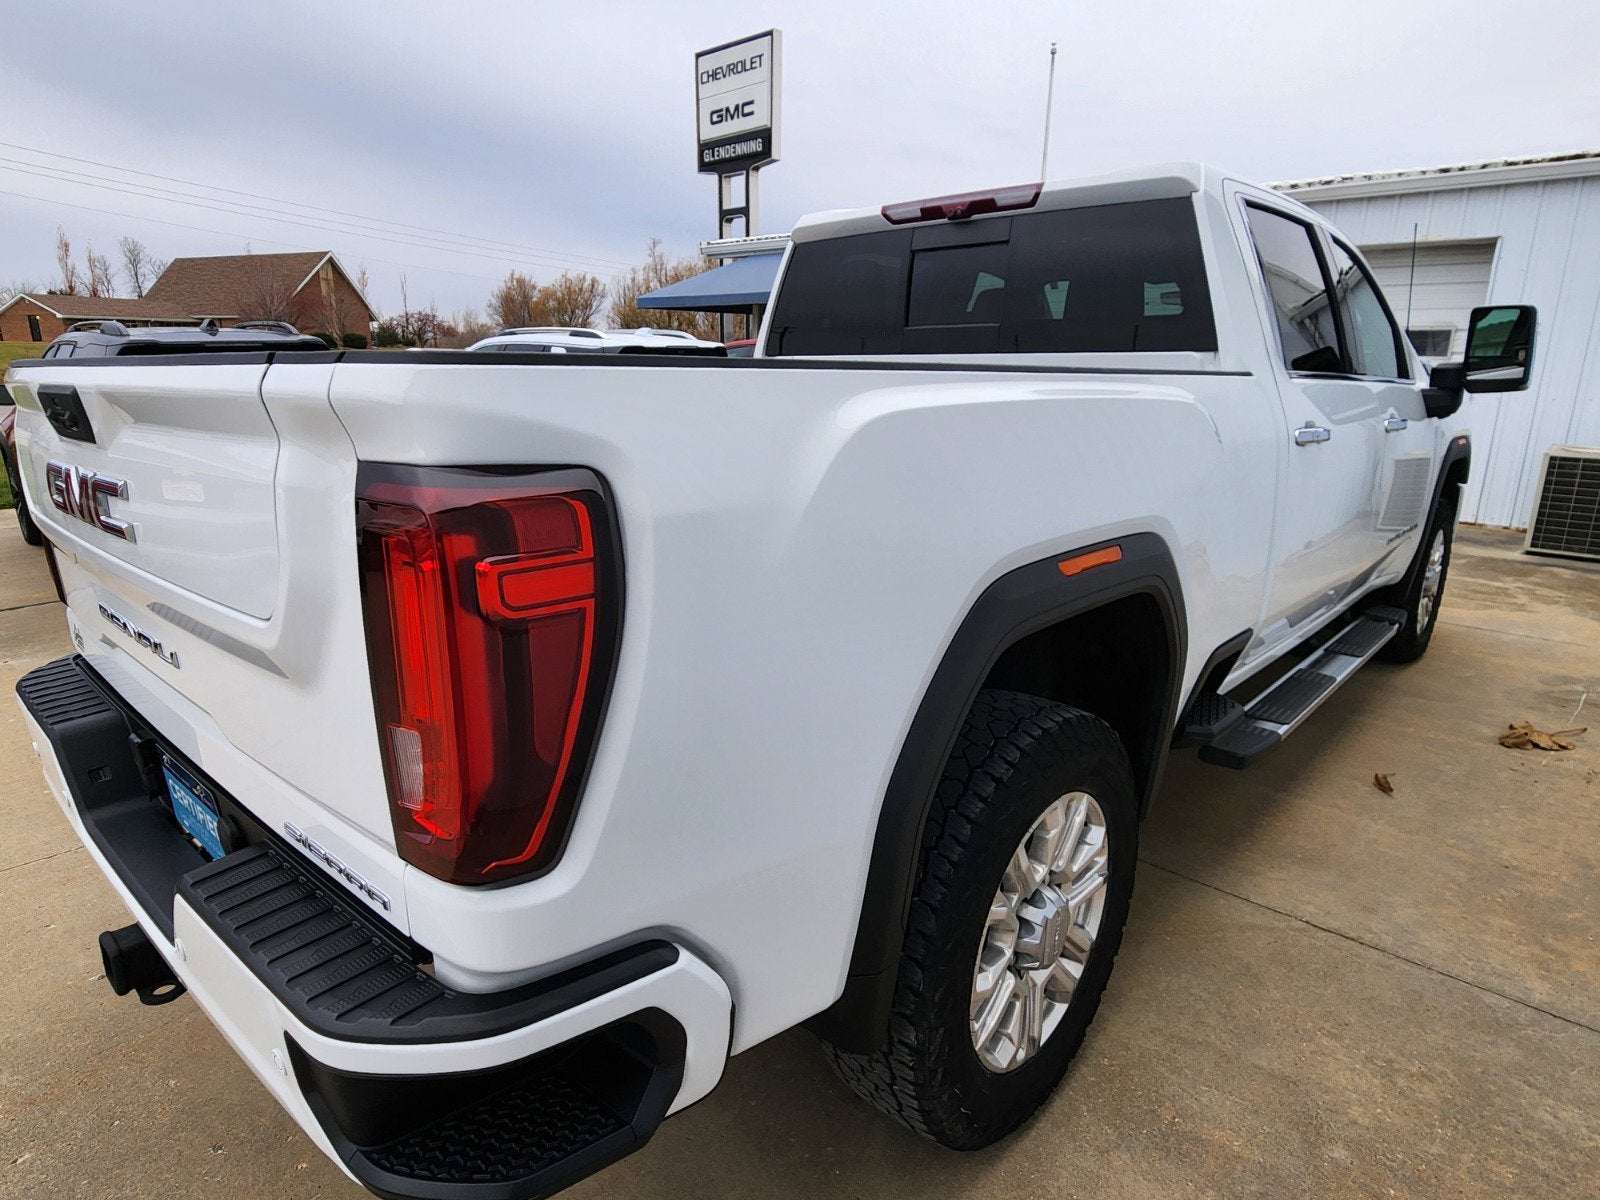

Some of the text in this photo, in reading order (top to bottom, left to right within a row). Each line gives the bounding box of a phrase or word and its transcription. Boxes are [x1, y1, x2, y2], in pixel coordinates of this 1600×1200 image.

[700, 53, 764, 85] CHEVROLET
[710, 99, 755, 125] GMC
[703, 138, 763, 162] GLENDENNING
[46, 459, 137, 545] GMC
[98, 601, 180, 670] DENALI
[283, 821, 392, 913] SIERRA
